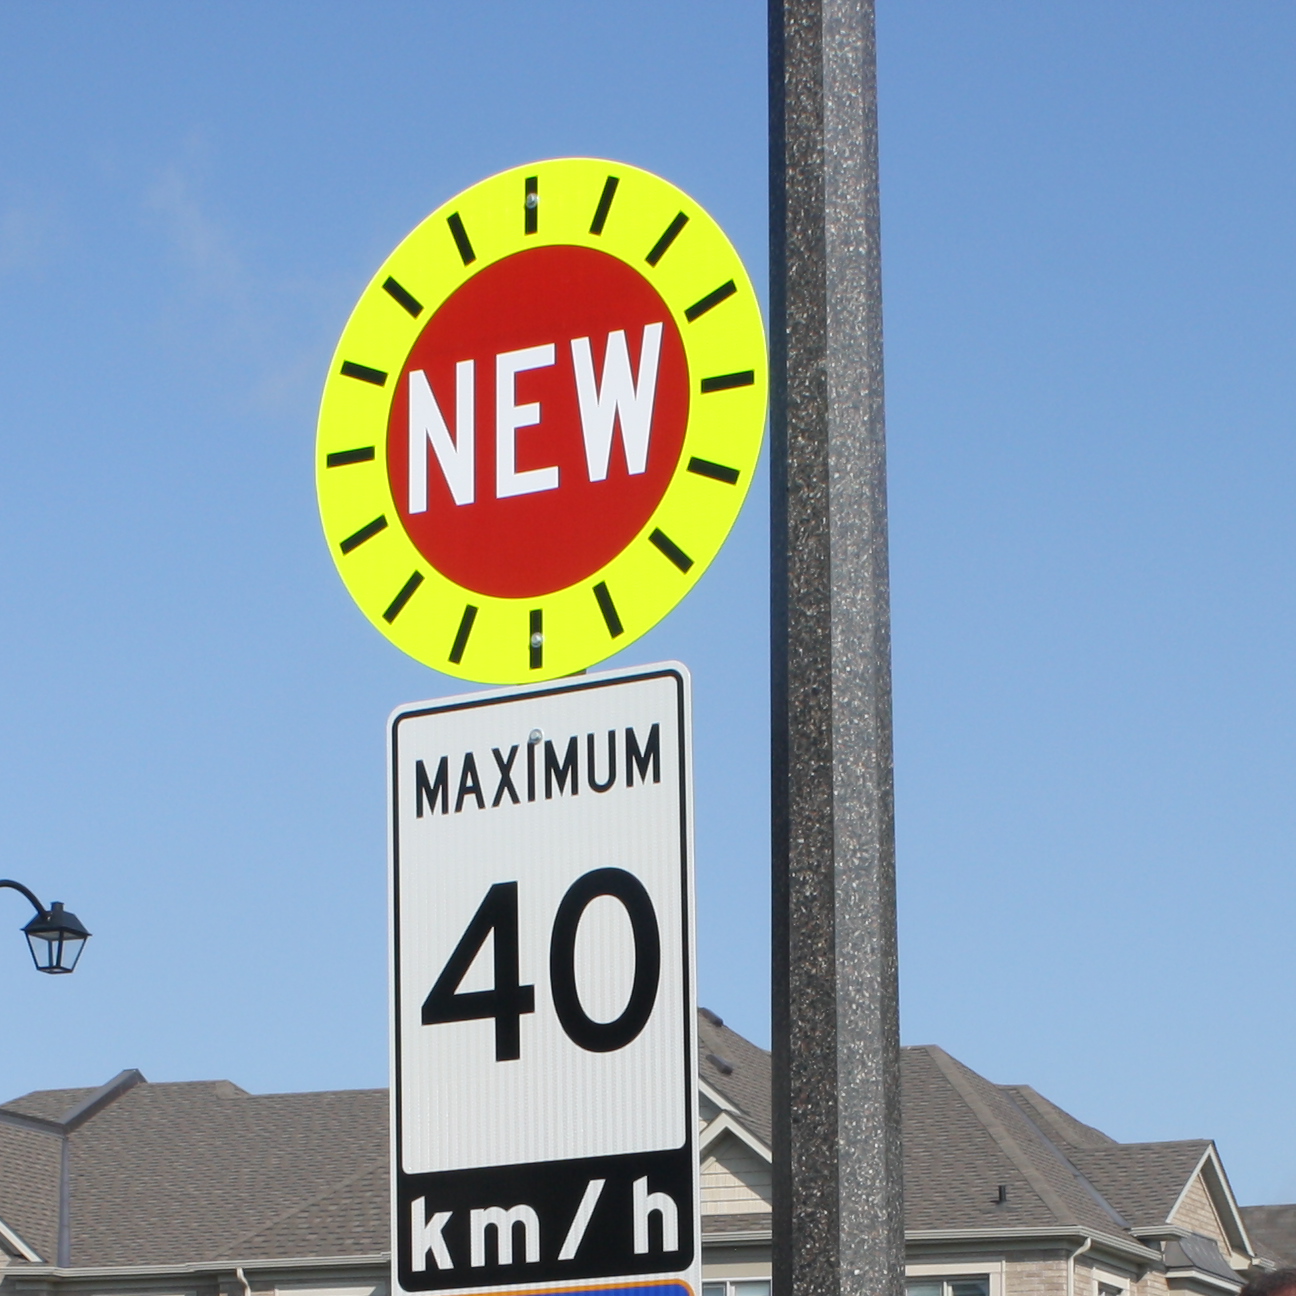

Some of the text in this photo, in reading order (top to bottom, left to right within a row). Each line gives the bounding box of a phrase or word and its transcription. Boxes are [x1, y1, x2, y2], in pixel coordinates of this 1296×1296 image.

[408, 321, 664, 515] NEW
[415, 722, 661, 819] MAXIMUM
[421, 866, 661, 1063] 40
